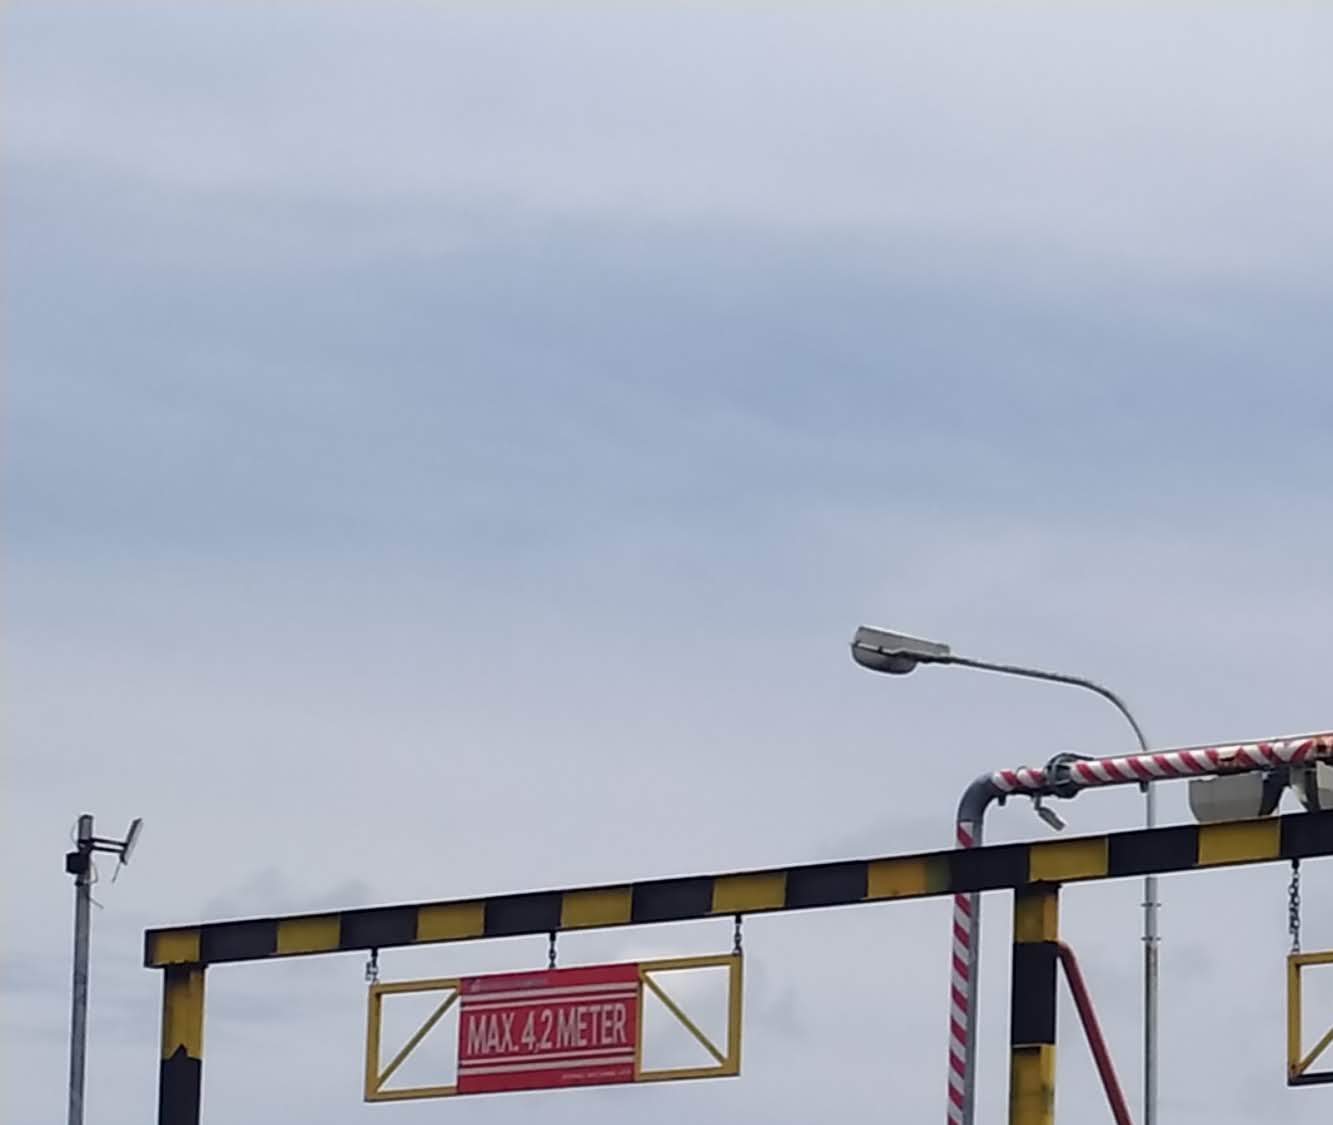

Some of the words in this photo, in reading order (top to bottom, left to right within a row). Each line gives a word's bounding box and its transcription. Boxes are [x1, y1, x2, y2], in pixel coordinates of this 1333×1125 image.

[467, 1012, 520, 1056] MAX.
[521, 1008, 553, 1054] 4,2
[556, 1003, 627, 1050] METER
